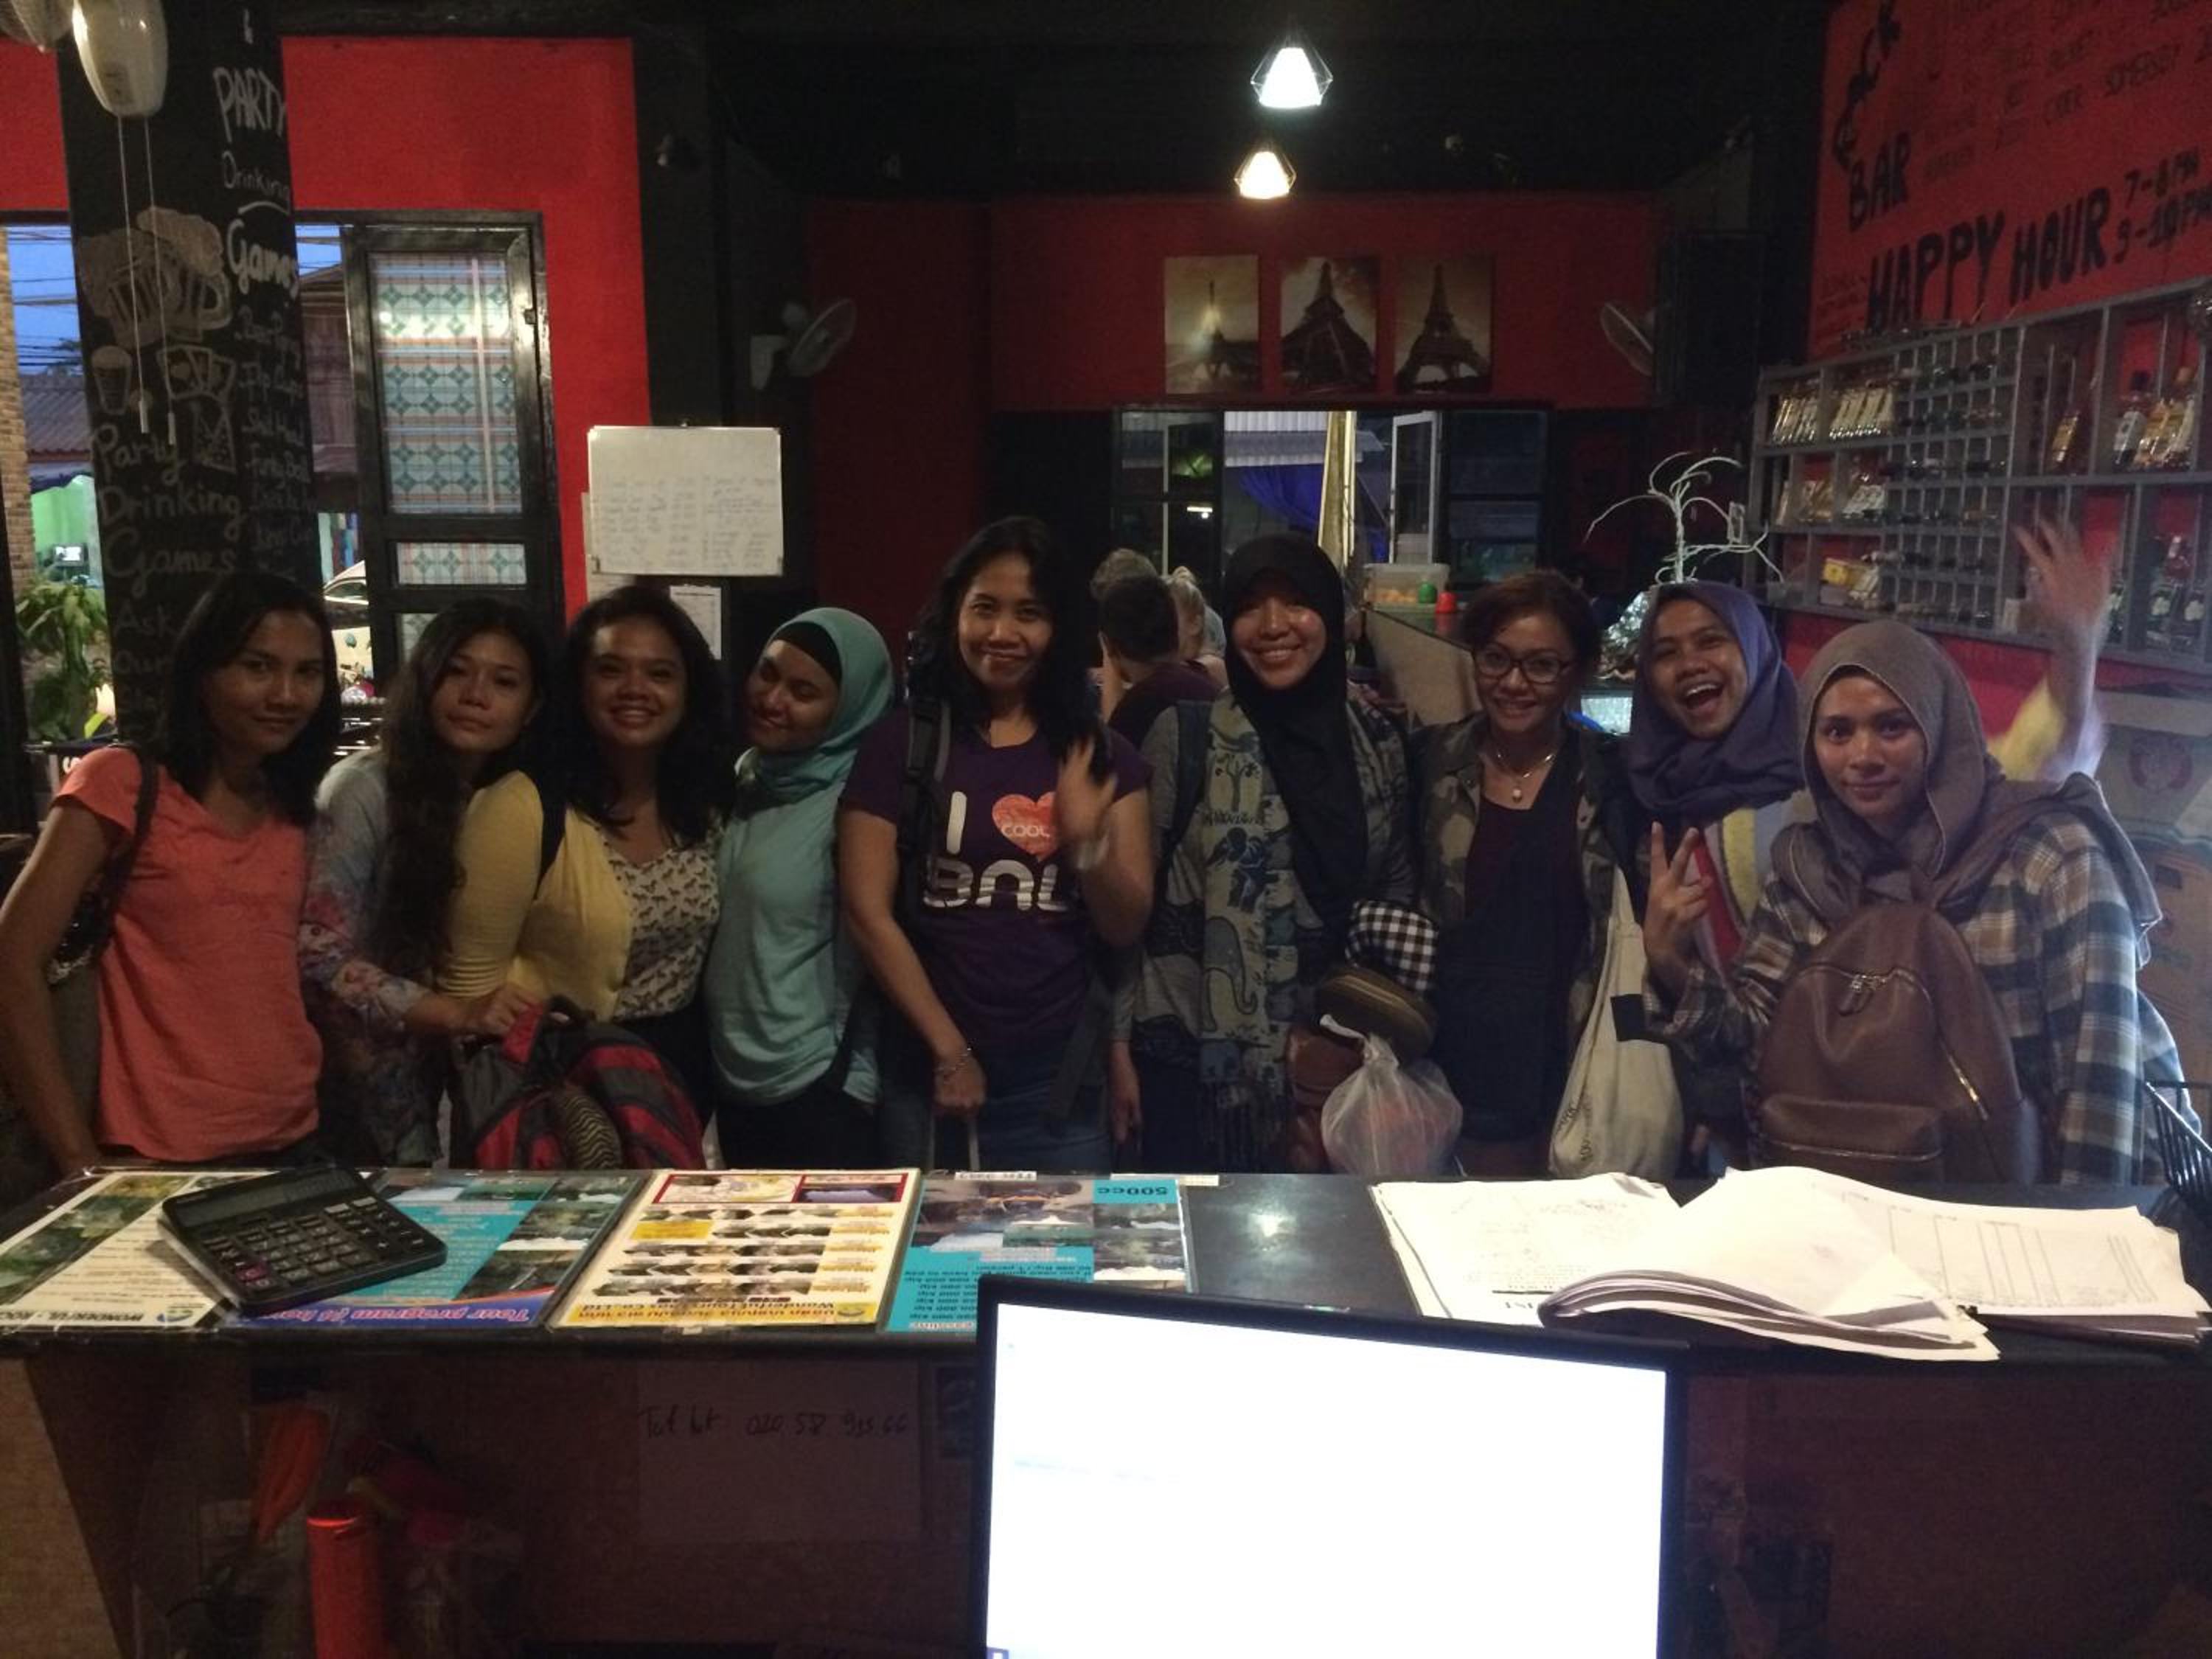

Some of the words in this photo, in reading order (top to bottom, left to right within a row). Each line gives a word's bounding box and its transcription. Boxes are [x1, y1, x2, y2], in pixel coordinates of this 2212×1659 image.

[213, 66, 287, 142] PARTY
[1849, 131, 1912, 233] BAR
[1865, 209, 2006, 329] HAPPY
[2009, 187, 2112, 306] HOUR
[94, 423, 186, 487] Party
[98, 480, 245, 541] Drinking
[103, 526, 238, 598] Games
[945, 790, 967, 856] I
[1097, 1186, 1168, 1196] 500cc
[49, 1312, 144, 1323] WONDERFUL
[349, 1307, 470, 1320] program
[469, 1309, 529, 1322] Tour
[742, 1302, 834, 1310] Wonderful
